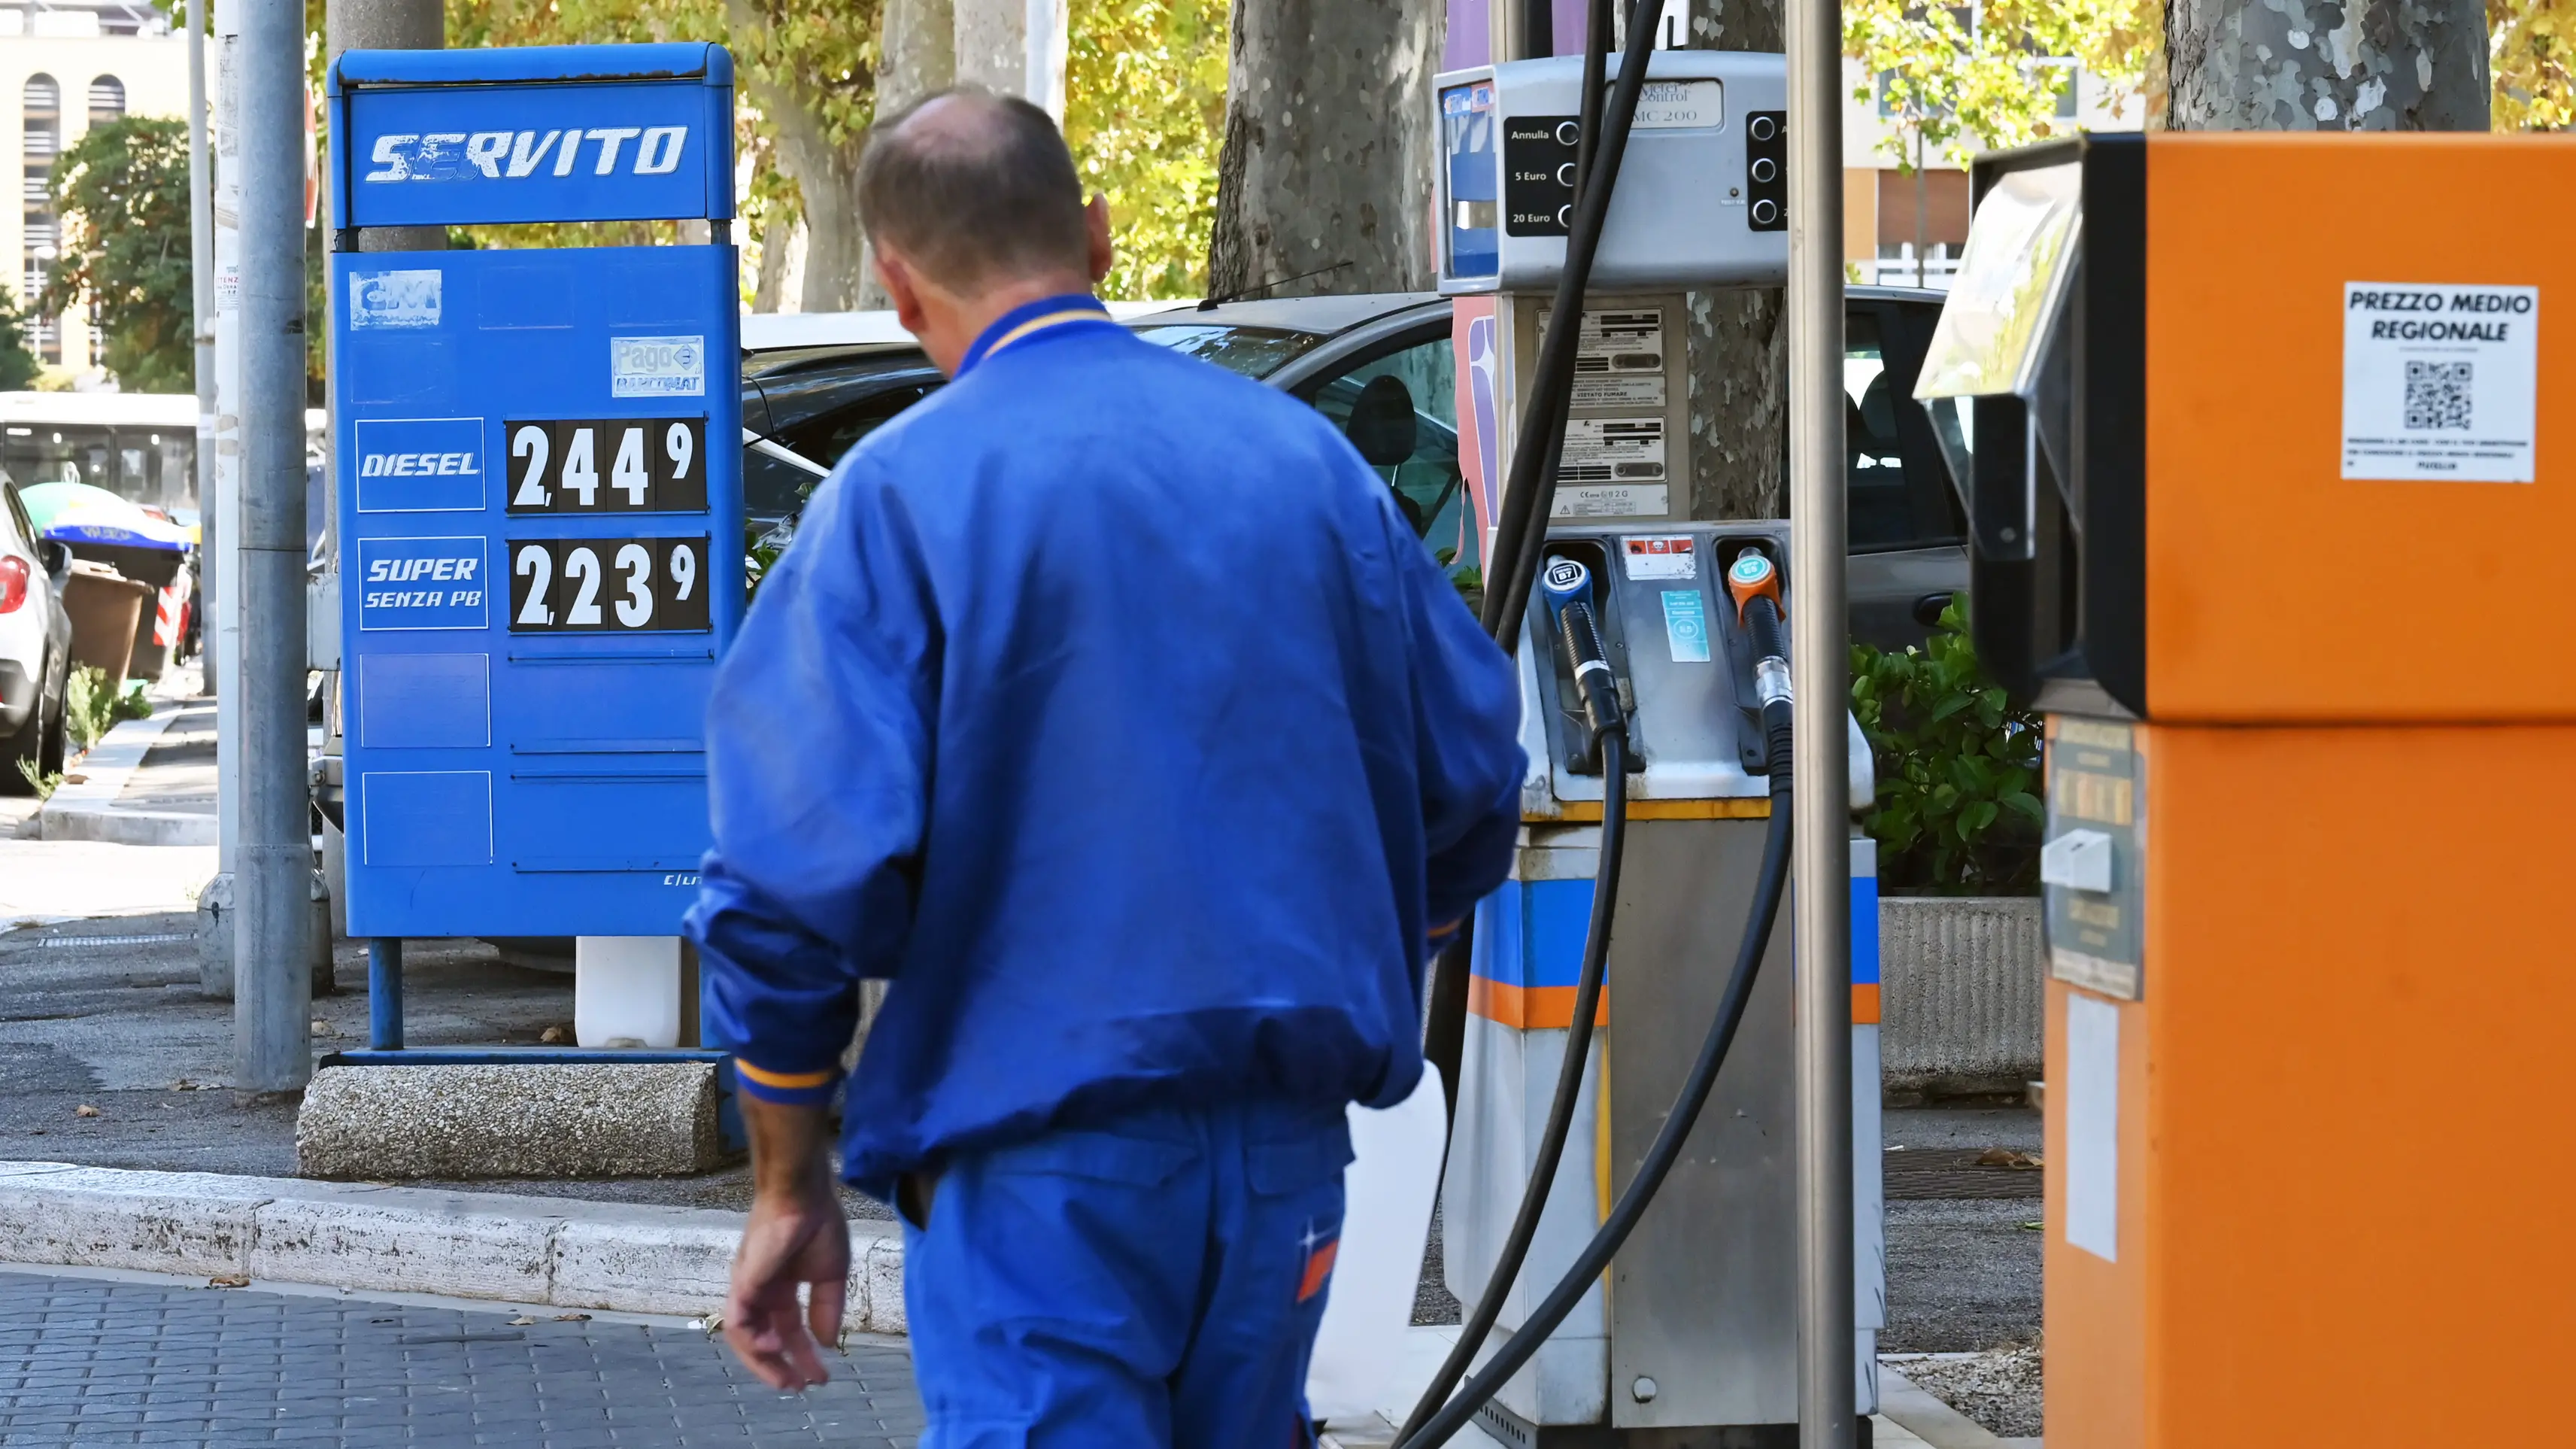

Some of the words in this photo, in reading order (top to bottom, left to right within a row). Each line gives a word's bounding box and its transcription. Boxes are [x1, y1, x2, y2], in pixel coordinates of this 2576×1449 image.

[1638, 89, 1688, 102] Control
[1640, 84, 1679, 96] Meter
[1664, 111, 1698, 122] 200
[1511, 130, 1550, 140] Annulla
[365, 126, 688, 184] SERVITO
[1515, 172, 1522, 181] 5
[1524, 172, 1547, 181] Euro
[1513, 214, 1525, 223] 20
[1528, 214, 1551, 223] Euro
[2349, 291, 2443, 311] PREZZO
[2450, 294, 2532, 314] MEDIO
[2371, 320, 2510, 342] REGIONALE
[614, 342, 672, 373] Pago
[360, 452, 481, 478] DIESEL
[366, 557, 478, 582] SUPER
[1558, 570, 1572, 581] B7
[364, 591, 441, 609] SENZA
[449, 591, 482, 607] PB
